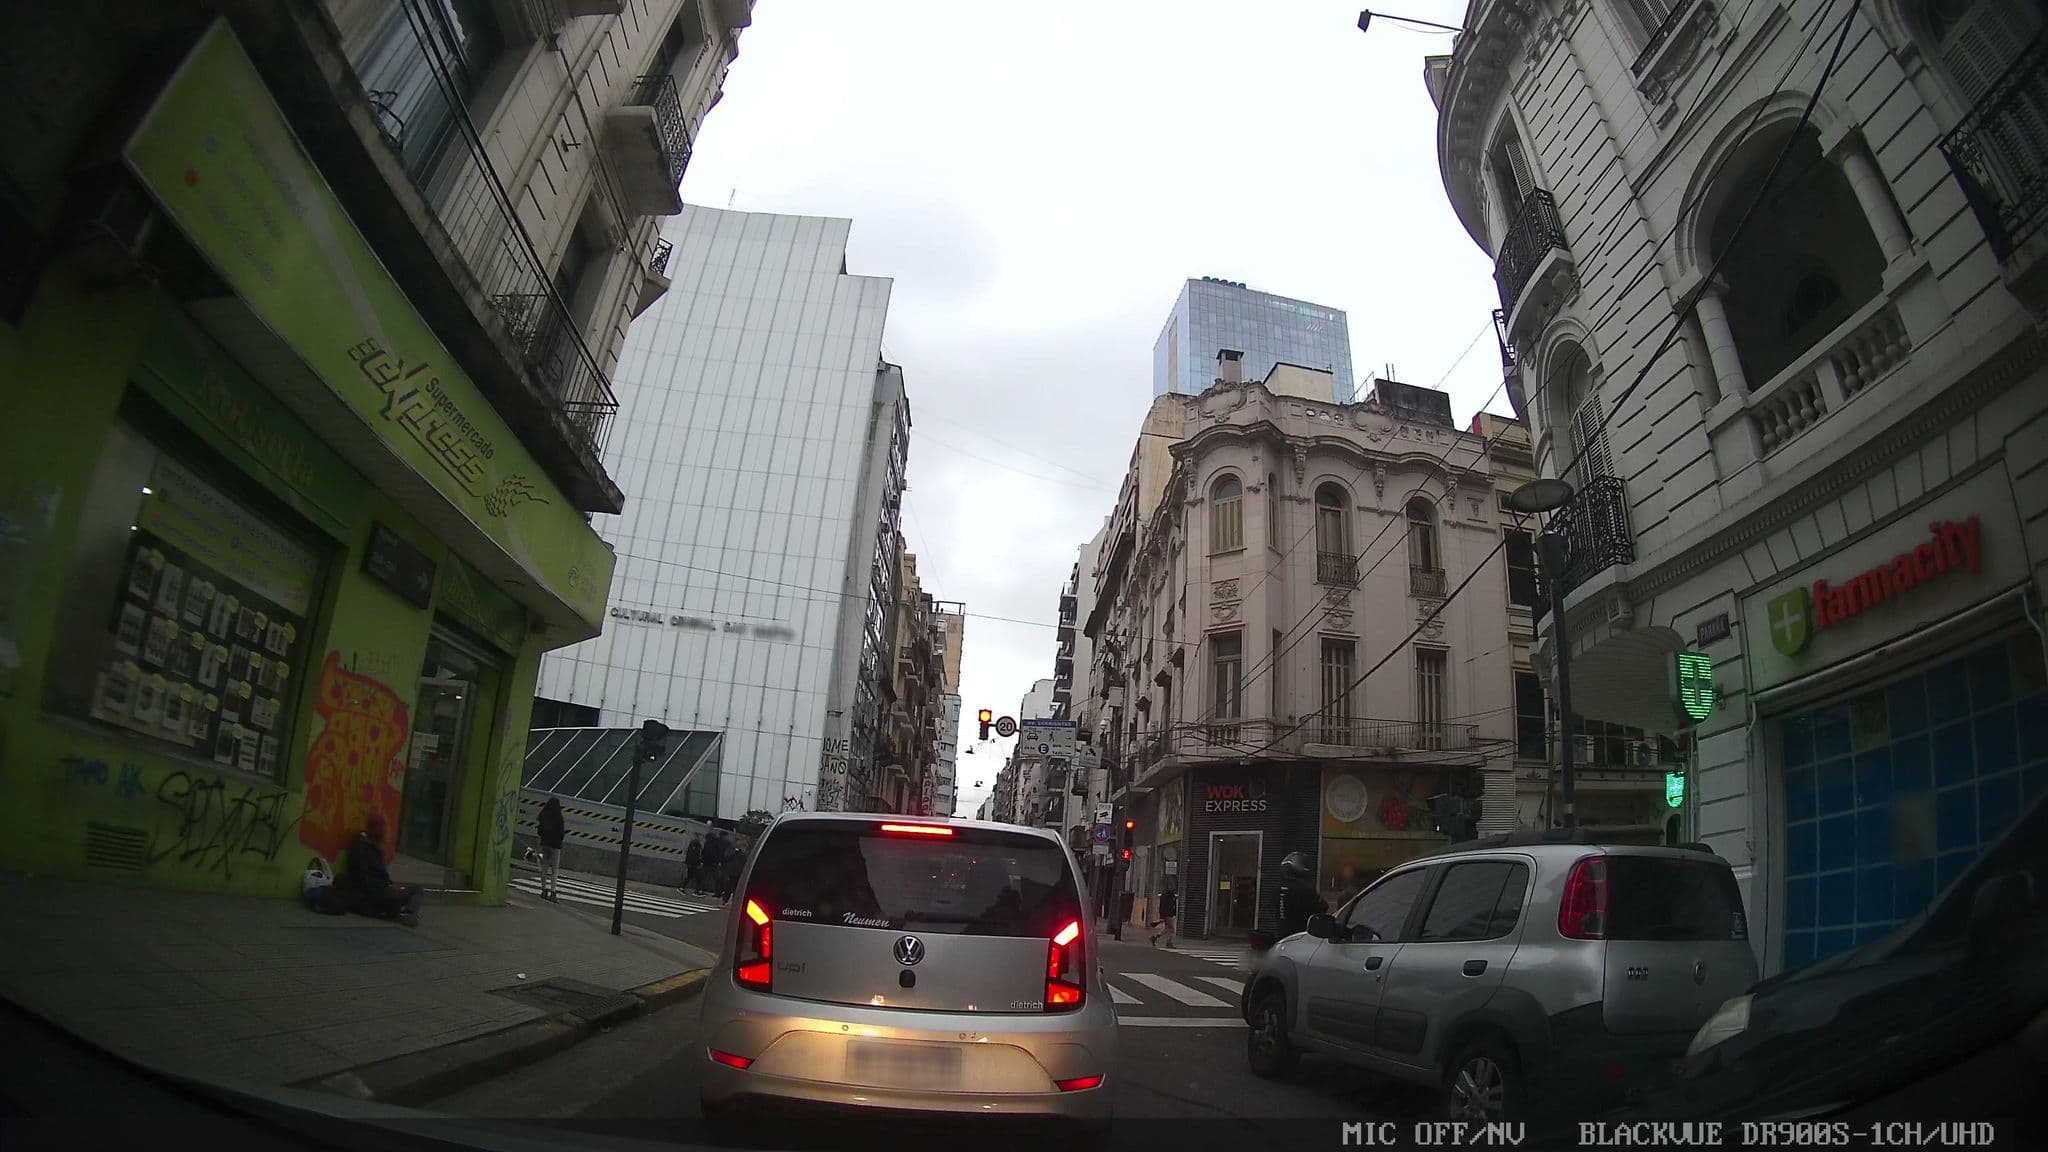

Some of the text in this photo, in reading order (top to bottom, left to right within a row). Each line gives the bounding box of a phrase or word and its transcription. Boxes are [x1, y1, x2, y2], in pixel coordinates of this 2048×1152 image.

[425, 377, 495, 460] Supermercado
[1809, 514, 1981, 630] farmacity
[999, 721, 1013, 733] 20
[1205, 799, 1267, 813] EXPRESS
[781, 907, 813, 918] dietrich
[842, 911, 891, 929] Neumen
[1010, 1000, 1044, 1010] dietrich
